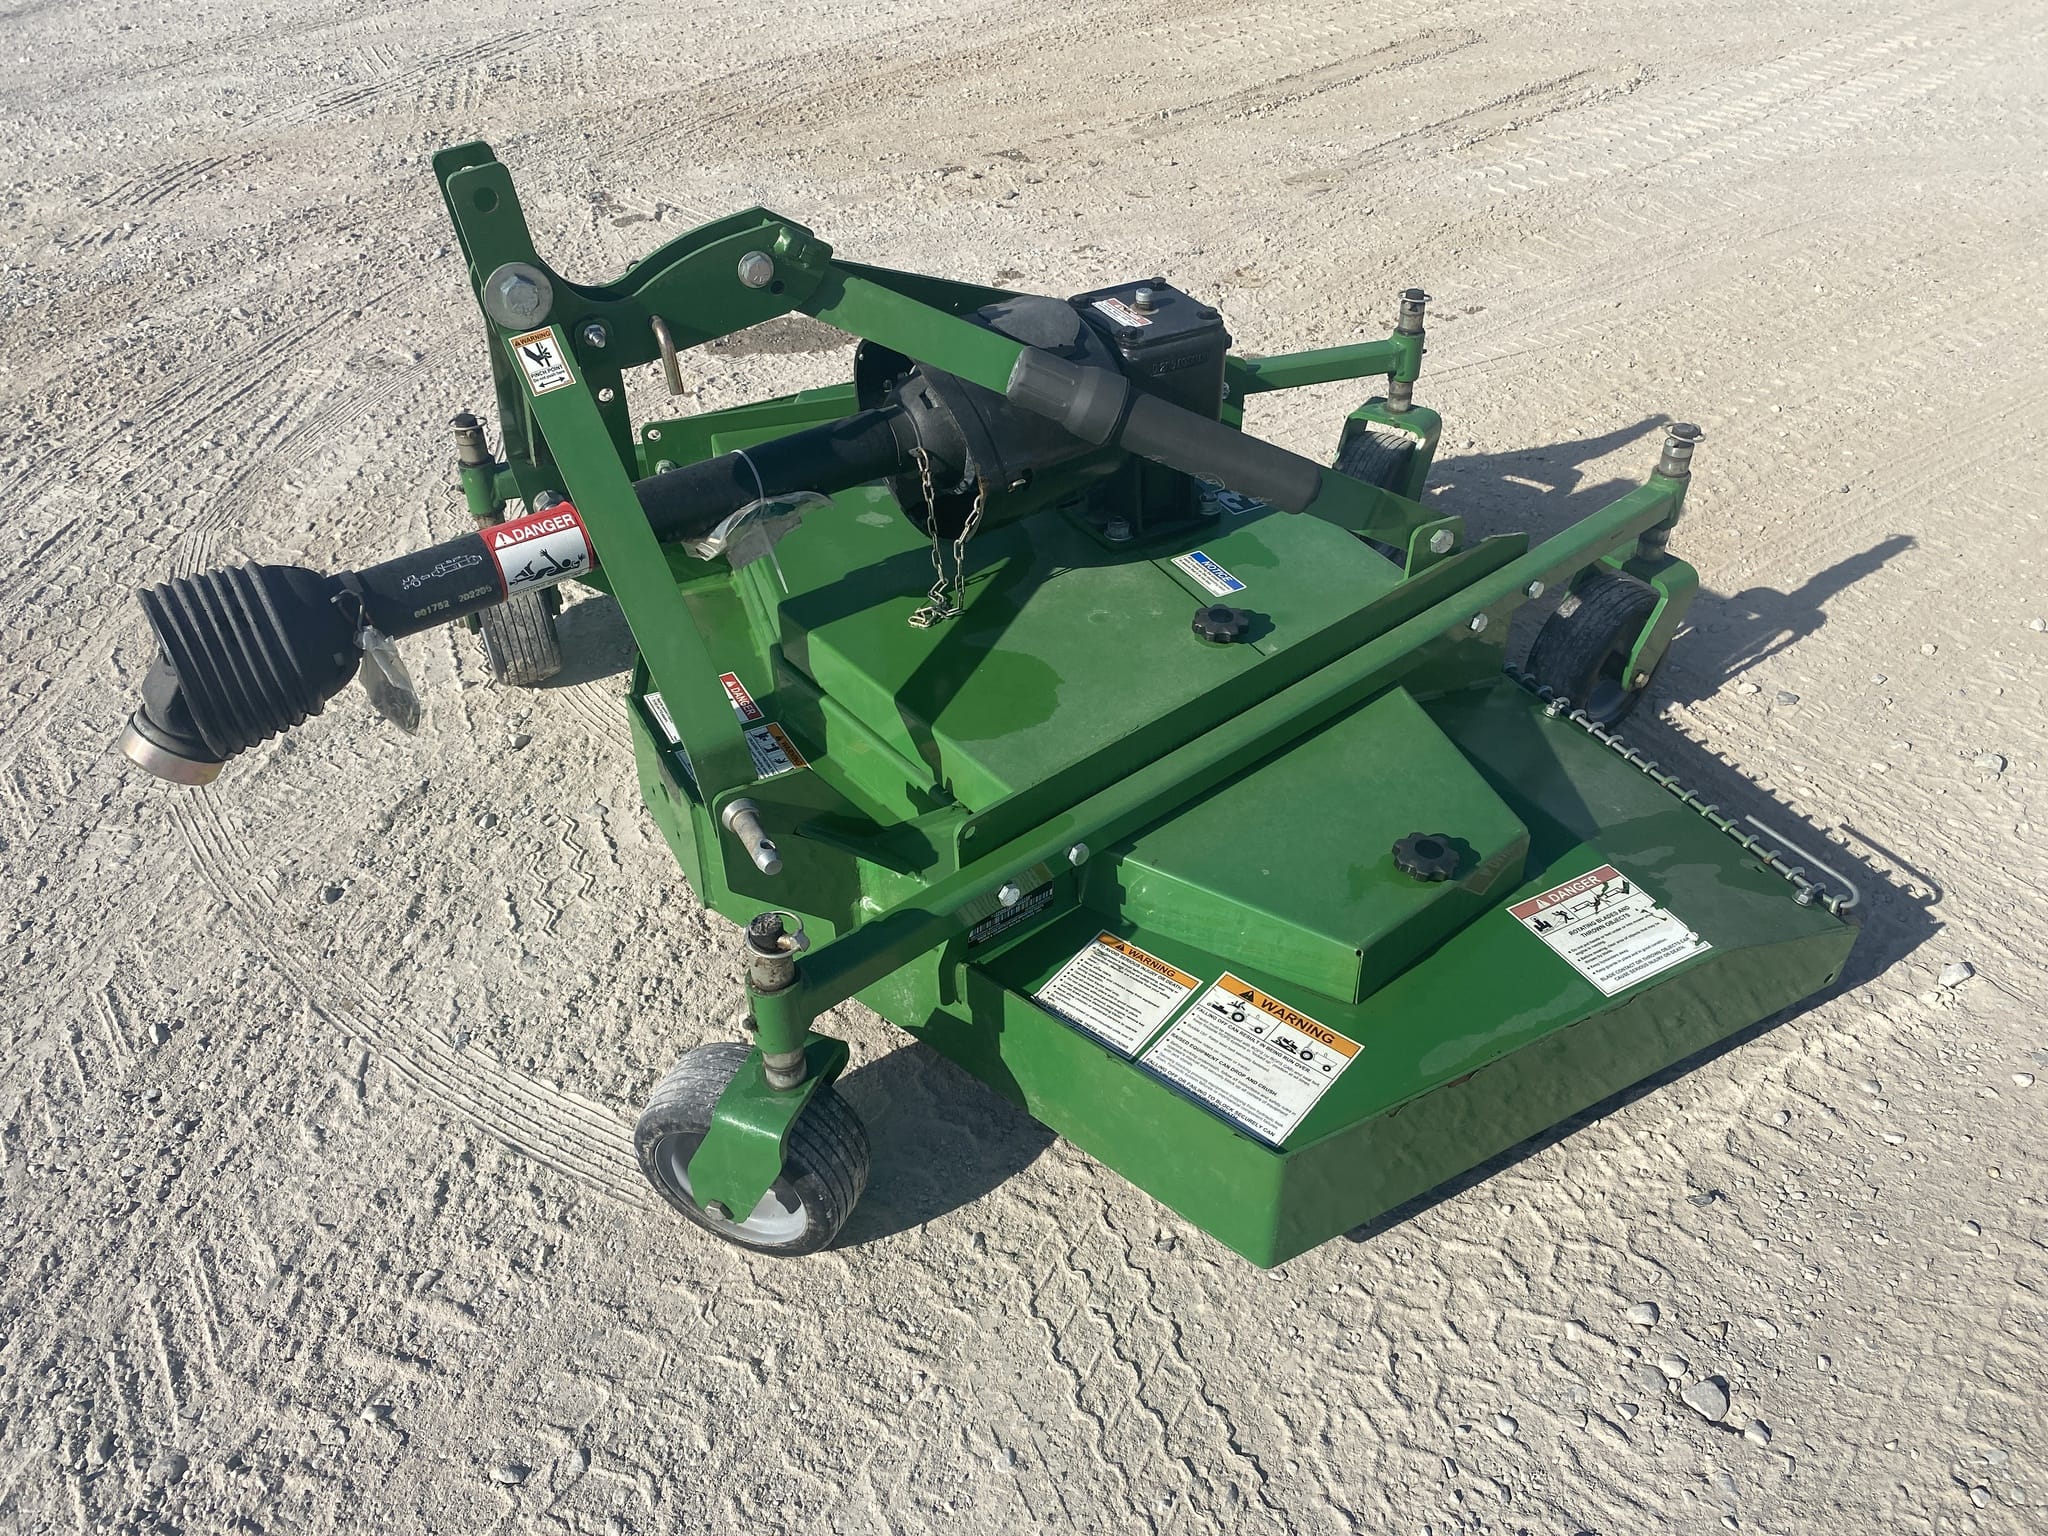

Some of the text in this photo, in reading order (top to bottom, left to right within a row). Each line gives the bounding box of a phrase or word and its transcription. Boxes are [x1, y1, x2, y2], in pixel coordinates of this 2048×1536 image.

[519, 330, 551, 344] WARNING
[512, 513, 577, 542] DANGER
[1200, 560, 1233, 582] NOTICE
[729, 686, 756, 715] DANGER
[1546, 874, 1602, 903] DANGER
[1567, 904, 1631, 936] ROTATING BLADES AND
[1579, 912, 1631, 938] THROWN OBJECTS
[1104, 947, 1120, 957] AVOID
[1118, 954, 1141, 968] SERIOUS
[1139, 965, 1158, 977] INJURY
[1126, 948, 1177, 978] WARNING
[1194, 1006, 1218, 1021] FALLING
[1216, 1018, 1228, 1026] OFF
[1226, 1024, 1240, 1033] CAN
[1237, 1030, 1260, 1044] RESULT
[1264, 1045, 1283, 1057] BEING
[1281, 1054, 1296, 1064] RUN
[1258, 998, 1336, 1045] WARNING
[1169, 1032, 1190, 1046] RAISED
[1187, 1042, 1220, 1062] EQUIPMENT
[1217, 1059, 1231, 1069] CAN
[1229, 1066, 1247, 1078] DROP
[1244, 1075, 1259, 1085] AND
[1144, 1057, 1168, 1073] FALLING
[1166, 1069, 1180, 1079] OFF
[1184, 1081, 1209, 1097] FAILING
[1213, 1098, 1235, 1112] BLOCK
[1232, 1109, 1264, 1129] SECURELY
[1261, 1126, 1276, 1137] CAN
